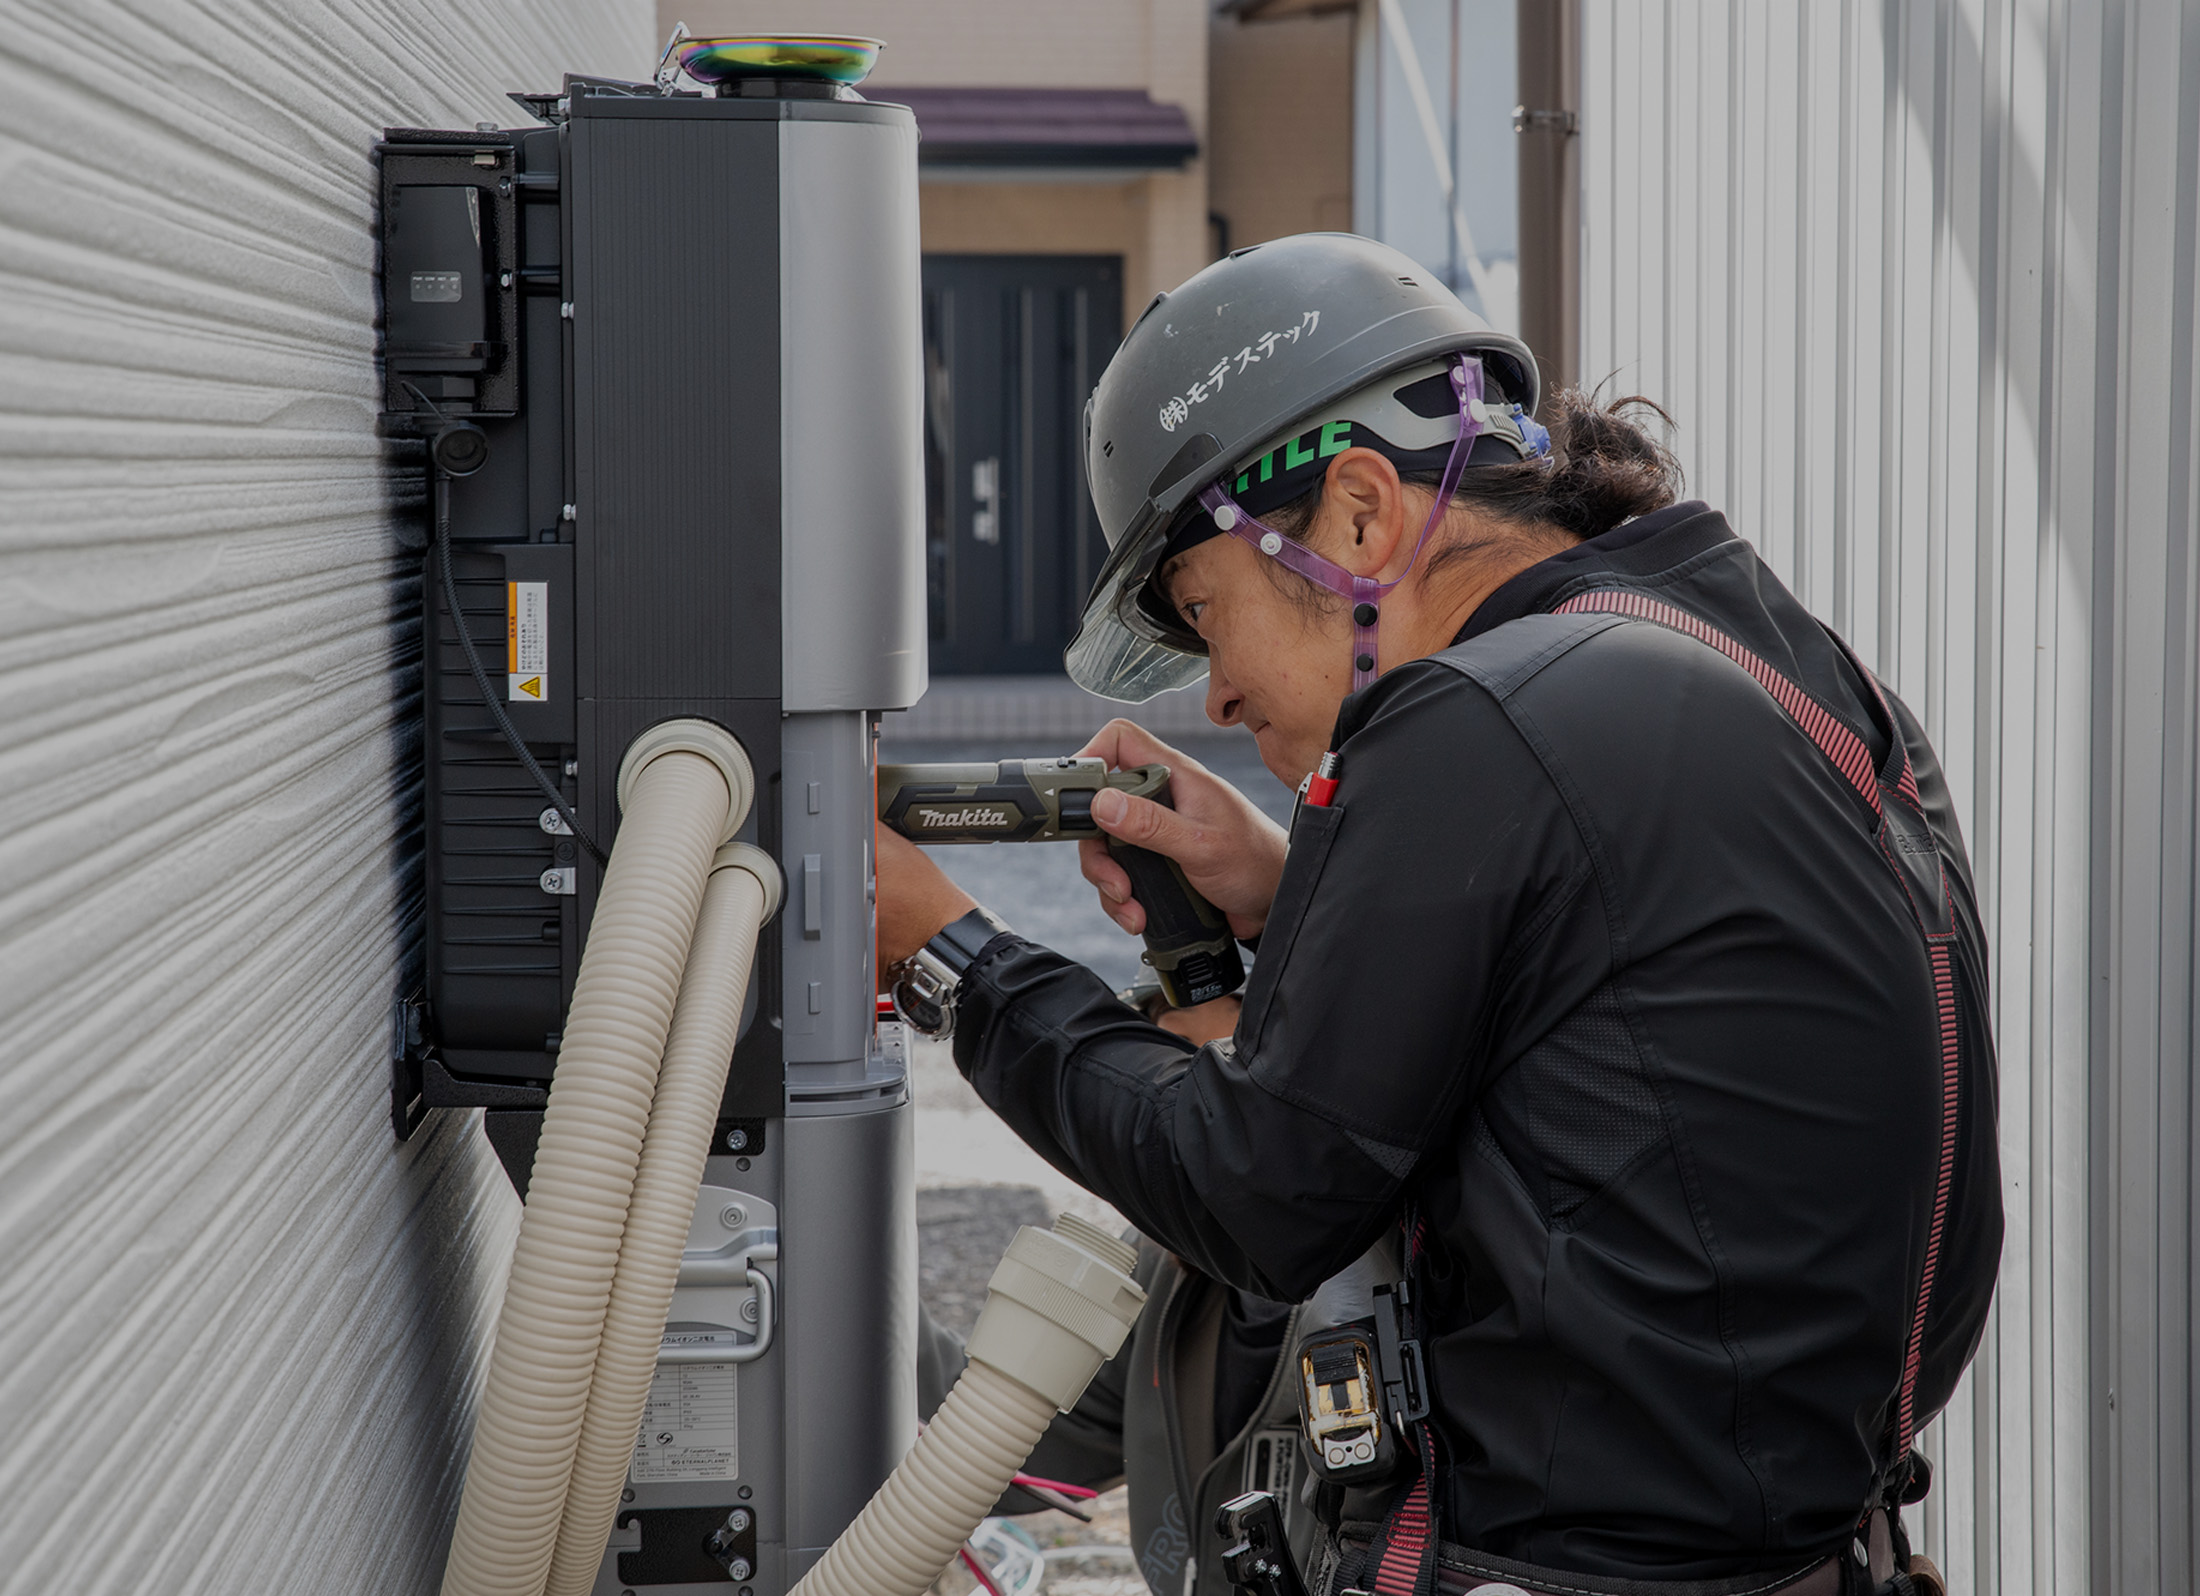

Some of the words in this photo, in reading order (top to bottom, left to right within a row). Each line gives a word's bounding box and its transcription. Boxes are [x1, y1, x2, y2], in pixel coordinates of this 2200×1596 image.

[661, 1336, 715, 1344] ウムイオン二次電池
